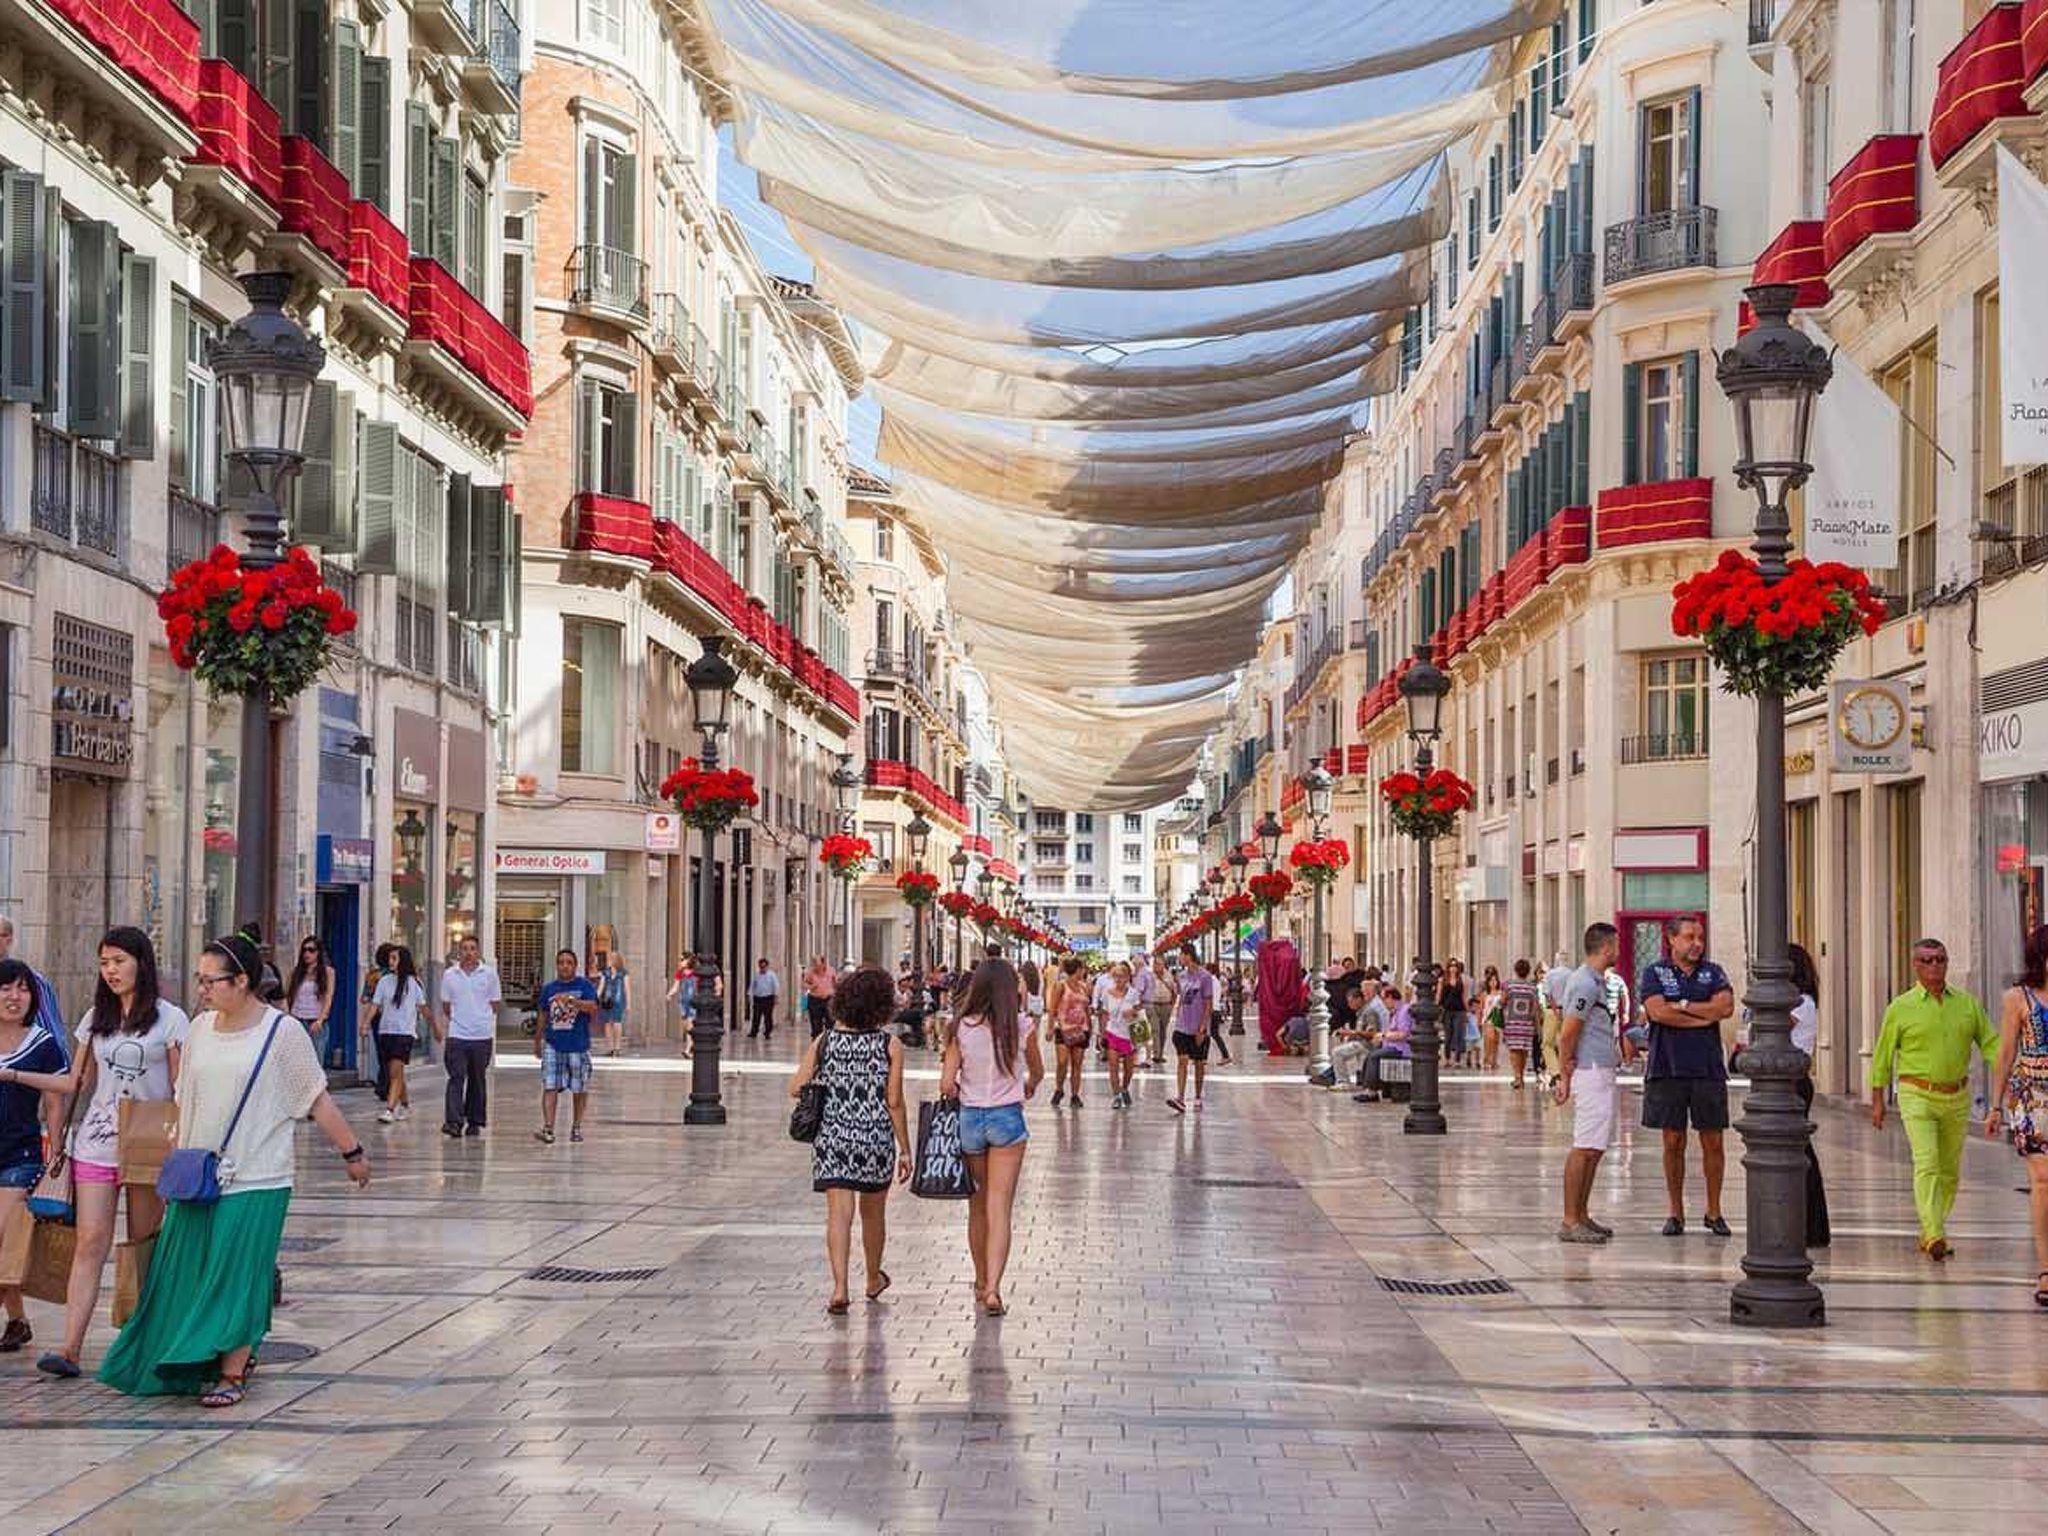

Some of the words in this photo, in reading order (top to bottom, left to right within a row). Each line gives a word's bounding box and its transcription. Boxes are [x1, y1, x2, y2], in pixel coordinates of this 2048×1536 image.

[1980, 713, 2023, 755] KIKO
[1852, 756, 1892, 766] ROLEX
[504, 854, 549, 868] General
[1576, 998, 1586, 1012] 3
